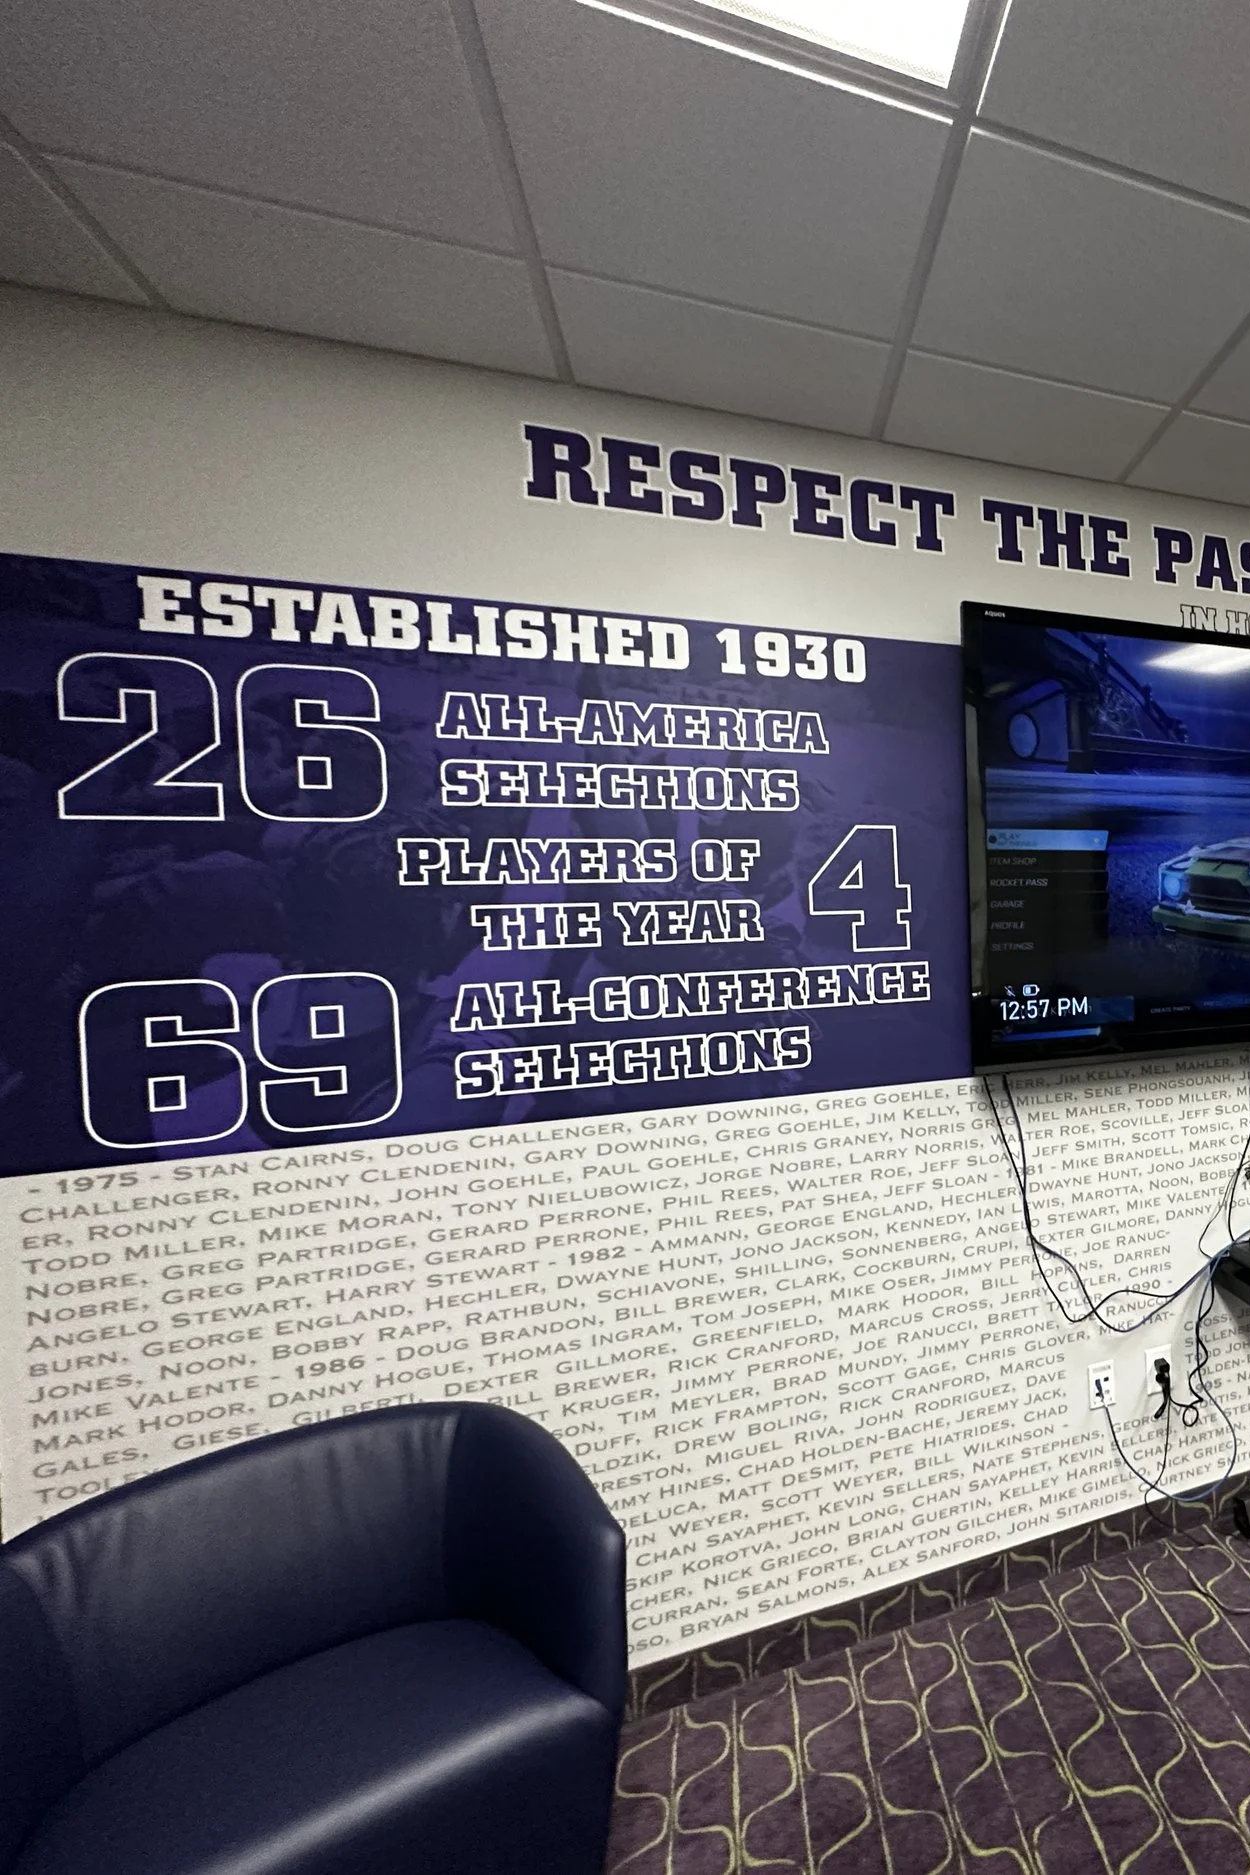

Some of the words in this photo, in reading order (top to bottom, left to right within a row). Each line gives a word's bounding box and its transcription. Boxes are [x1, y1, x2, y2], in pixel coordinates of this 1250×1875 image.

[523, 422, 956, 554] RESPECT
[982, 497, 1131, 579] THE
[137, 574, 690, 670] ESTABLISHED
[715, 630, 868, 684] 1930
[1180, 603, 1217, 630] IN
[57, 652, 388, 822] 26
[436, 691, 829, 756] ALL-AMERICA
[440, 758, 799, 812] SELECTIONS
[397, 838, 677, 887] PLAYERS
[690, 838, 761, 883] OF
[807, 825, 913, 953] 4
[990, 878, 1024, 887] ROCKET
[1025, 878, 1048, 887] PASS
[1011, 857, 1037, 865] SHOP
[470, 903, 601, 952] THE
[613, 899, 763, 948] YEAR
[990, 899, 1025, 908] GARAGE
[991, 920, 1025, 930] PROFILE
[991, 942, 1034, 952] SETTINGS
[450, 961, 931, 1032] ALL-CONFERENCE
[1000, 999, 1050, 1022] 12:57
[1057, 996, 1088, 1017] PM
[79, 971, 402, 1149] 69
[455, 1026, 813, 1101] SELECTIONS
[19, 1187, 240, 1224] CHALLENGER,
[253, 1174, 349, 1196] RONNY
[361, 1153, 515, 1184] CLENDENIN,
[524, 1147, 587, 1165] GARY
[596, 1133, 708, 1157] DOWNING,
[715, 1124, 771, 1142] GREG
[777, 1115, 860, 1135] GOEHLE,
[866, 1110, 897, 1125] JIM
[903, 1099, 960, 1120] KELLY,
[56, 1172, 139, 1195] 1975
[173, 1161, 249, 1181] STAN
[261, 1149, 374, 1172] CAIRNS,
[385, 1139, 459, 1159] DOUG
[468, 1121, 632, 1150] CHALLENGER,
[641, 1112, 698, 1131] GARY
[706, 1102, 809, 1124] DOWNING,
[816, 1095, 867, 1111] GREG
[873, 1087, 950, 1105] GOEHLE,
[22, 1231, 75, 1251] ER,
[88, 1216, 196, 1241] RONNY
[209, 1194, 380, 1226] CLENDENIN,
[392, 1183, 458, 1203] JOHN
[467, 1170, 573, 1193] GOEHLE,
[583, 1161, 640, 1180] PAUL
[647, 1151, 739, 1171] GOEHLE,
[746, 1141, 809, 1159] CHRIS
[814, 1132, 893, 1150] GRANEY,
[22, 1251, 111, 1275] TODD
[125, 1234, 246, 1261] MILLER,
[258, 1222, 328, 1244] MIKE
[338, 1209, 442, 1233] MORAN,
[452, 1197, 527, 1219] TONY
[528, 1177, 690, 1208] NIELUBOWICZ,
[696, 1166, 763, 1185] JORGE
[770, 1156, 842, 1175] NOBRE,
[568, 1246, 627, 1267] 1982
[651, 1230, 749, 1253] AMMANN,
[756, 1215, 835, 1236] GEORGE
[842, 1201, 935, 1224] ENGLAND,
[680, 1611, 750, 1638] BRYAN
[757, 1577, 856, 1613] SALMONS,
[862, 1559, 910, 1581] ALEX
[916, 1533, 1001, 1563] SANFORD,
[1006, 1515, 1050, 1536] JOHN
[1056, 1489, 1133, 1521] SITARIDIS,
